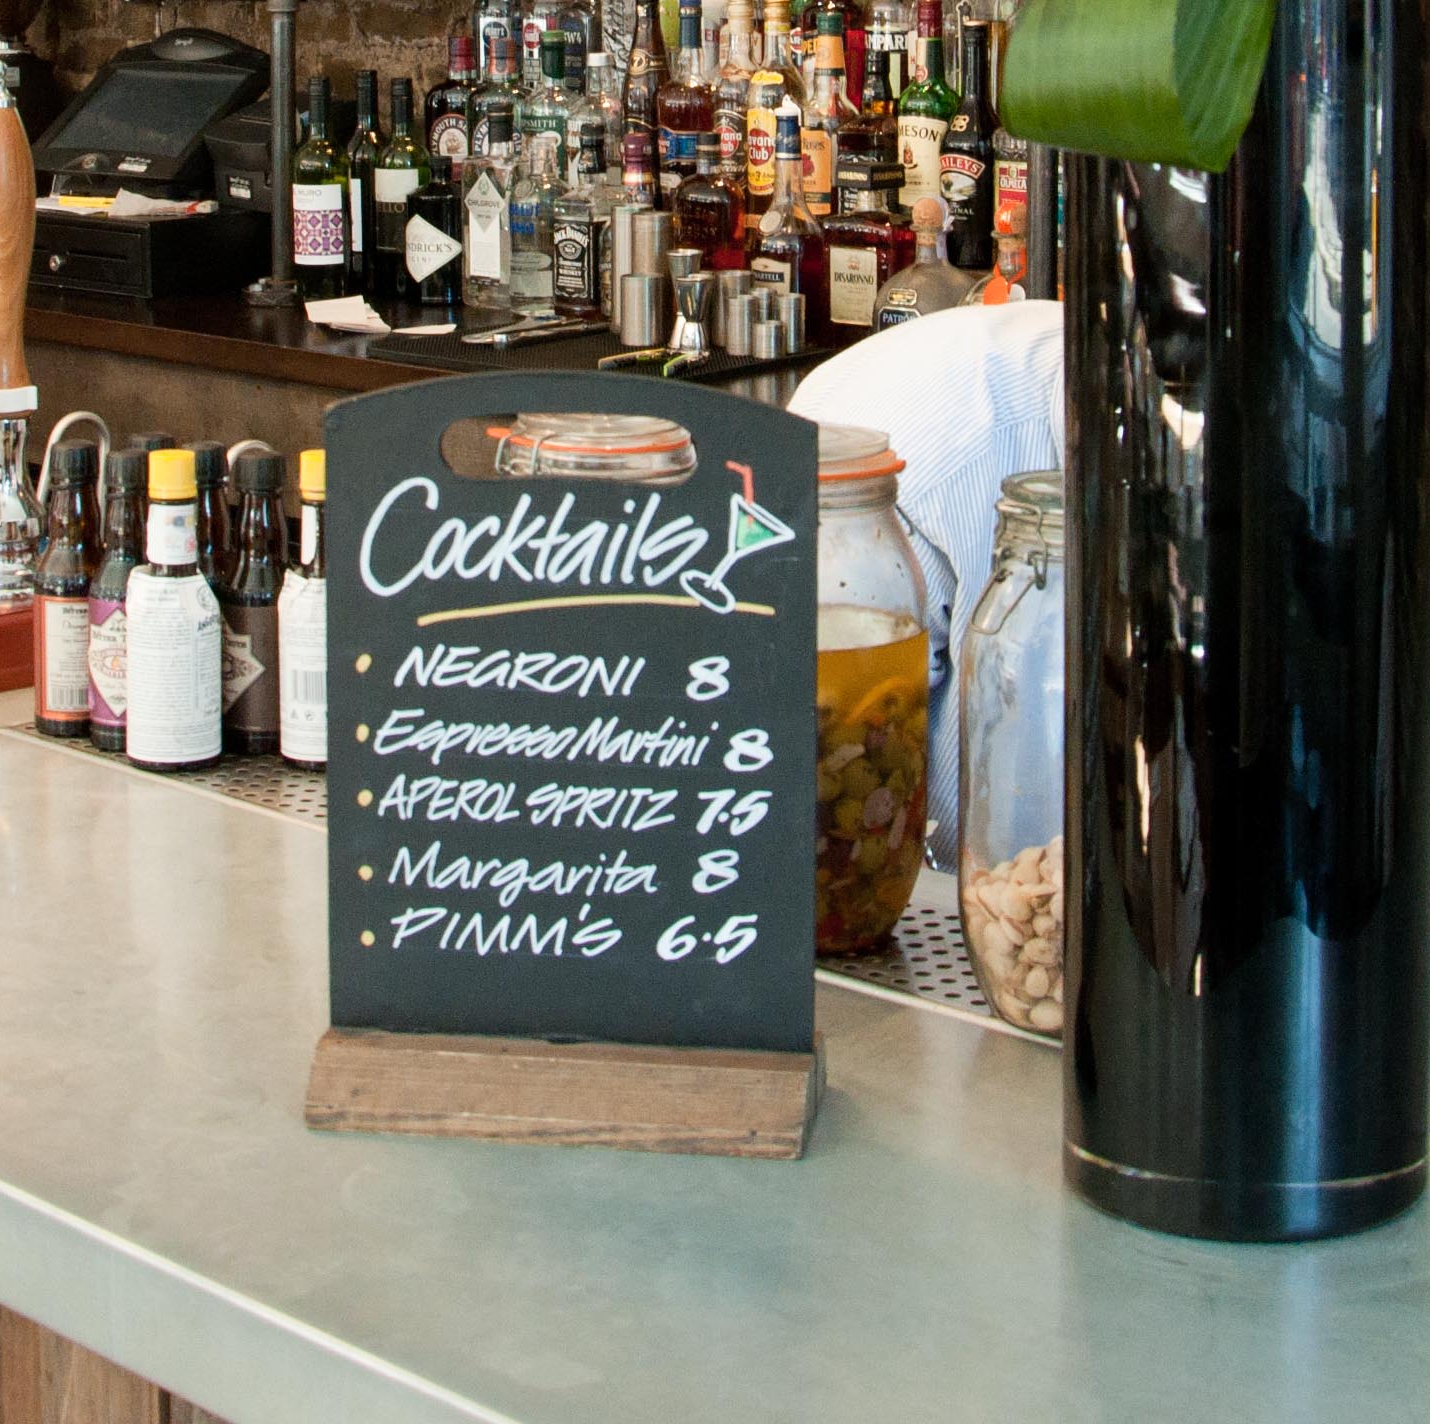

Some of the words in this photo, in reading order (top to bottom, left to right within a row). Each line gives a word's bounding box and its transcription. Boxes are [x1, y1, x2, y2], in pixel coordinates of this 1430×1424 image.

[834, 271, 875, 286] DISARONNO
[359, 478, 708, 597] Cocktails
[393, 644, 645, 698] NEGRONI
[686, 657, 731, 702] 8
[723, 728, 773, 772] 8
[378, 776, 520, 824] APEROL
[526, 784, 678, 832] SPRITZ
[696, 789, 772, 836] 7.5
[388, 842, 658, 909] Margarita
[691, 850, 739, 894] 8
[657, 914, 757, 964] 6.5
